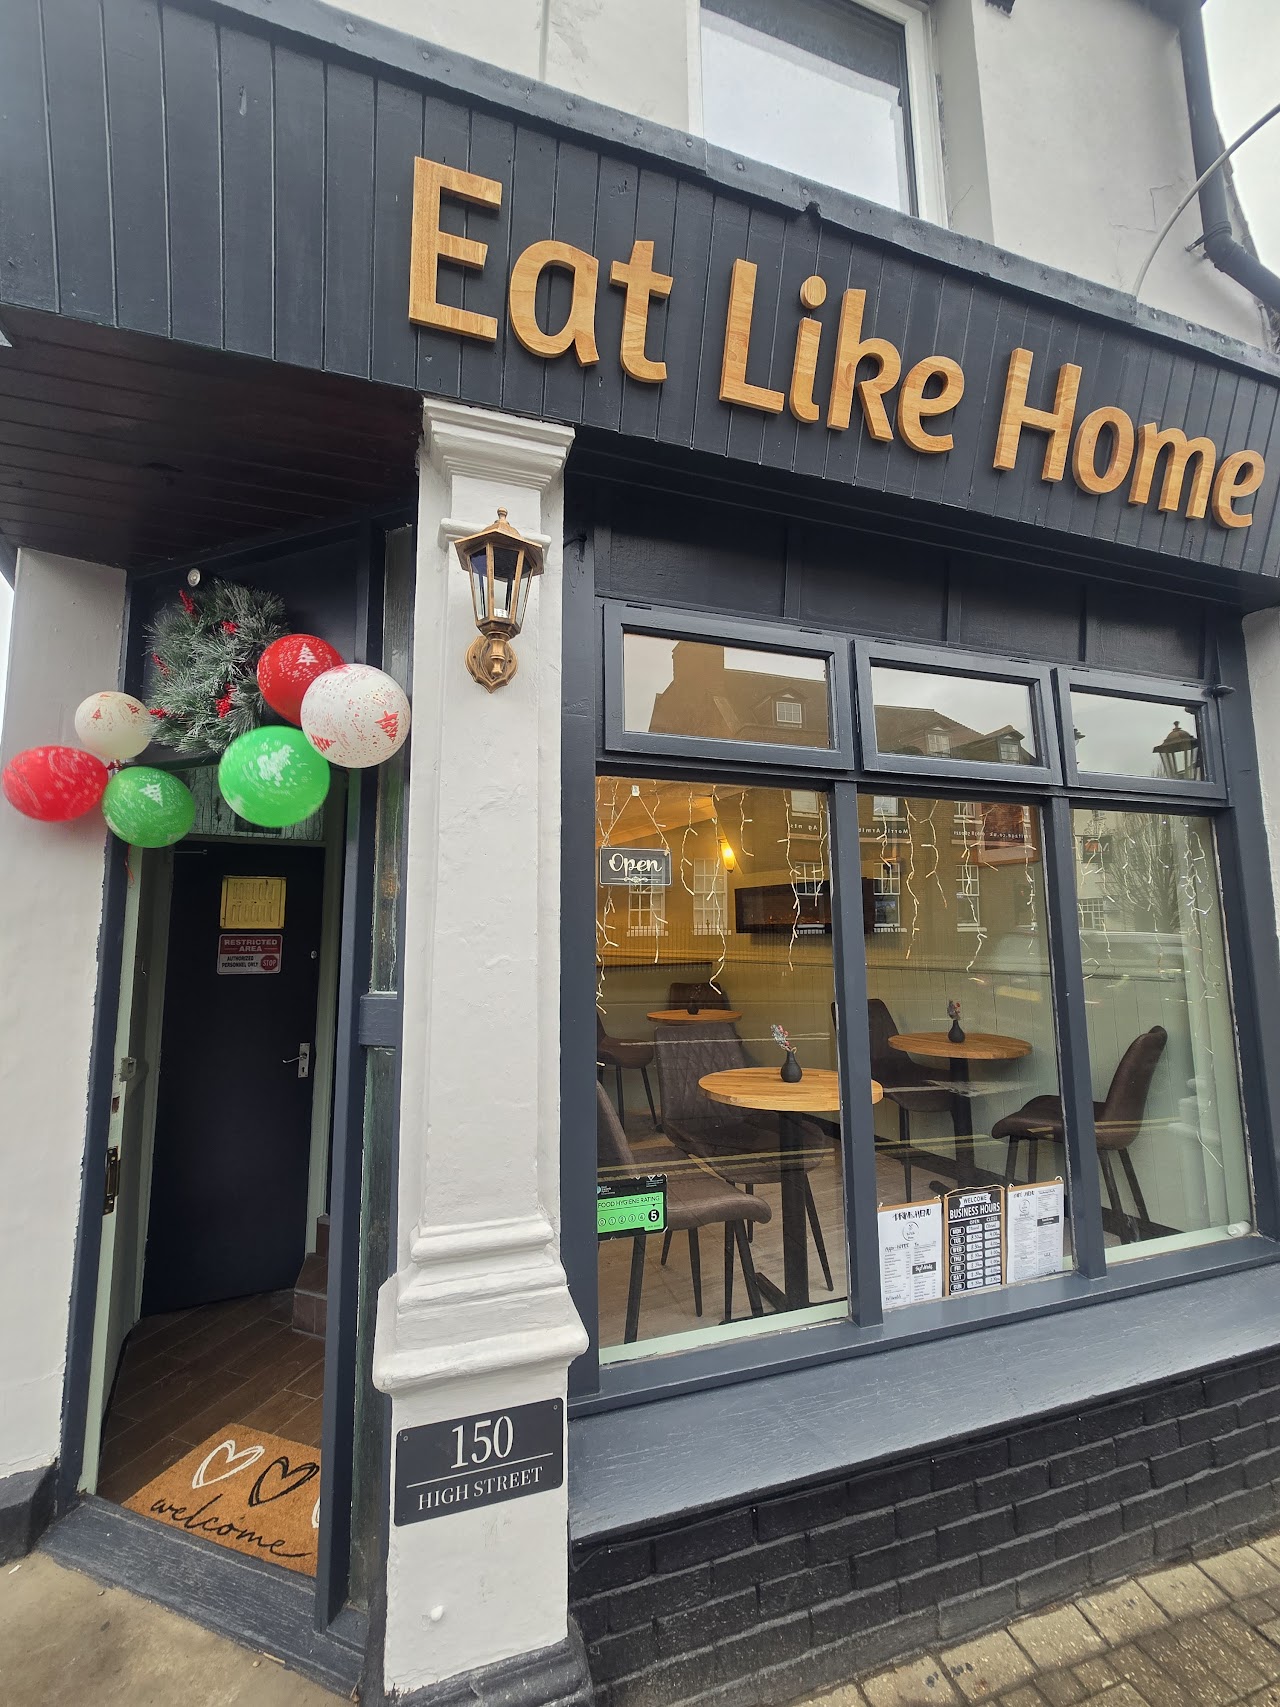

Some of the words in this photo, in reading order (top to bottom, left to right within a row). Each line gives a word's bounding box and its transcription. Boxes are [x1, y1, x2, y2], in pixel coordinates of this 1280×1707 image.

[408, 156, 673, 384] Eat
[719, 258, 965, 453] Like
[993, 347, 1265, 530] Home
[609, 853, 662, 877] Open
[262, 959, 277, 967] STOP
[616, 1198, 640, 1206] HYGIENE
[640, 1195, 660, 1203] RATING
[963, 1195, 988, 1204] WELCOME
[650, 1210, 657, 1221] 5
[949, 1205, 979, 1219] BUSINESS
[980, 1202, 1000, 1215] HOURS
[450, 1415, 514, 1469] 150
[418, 1484, 469, 1511] HIGH
[473, 1466, 543, 1498] STREET
[150, 1493, 312, 1557] welcome
